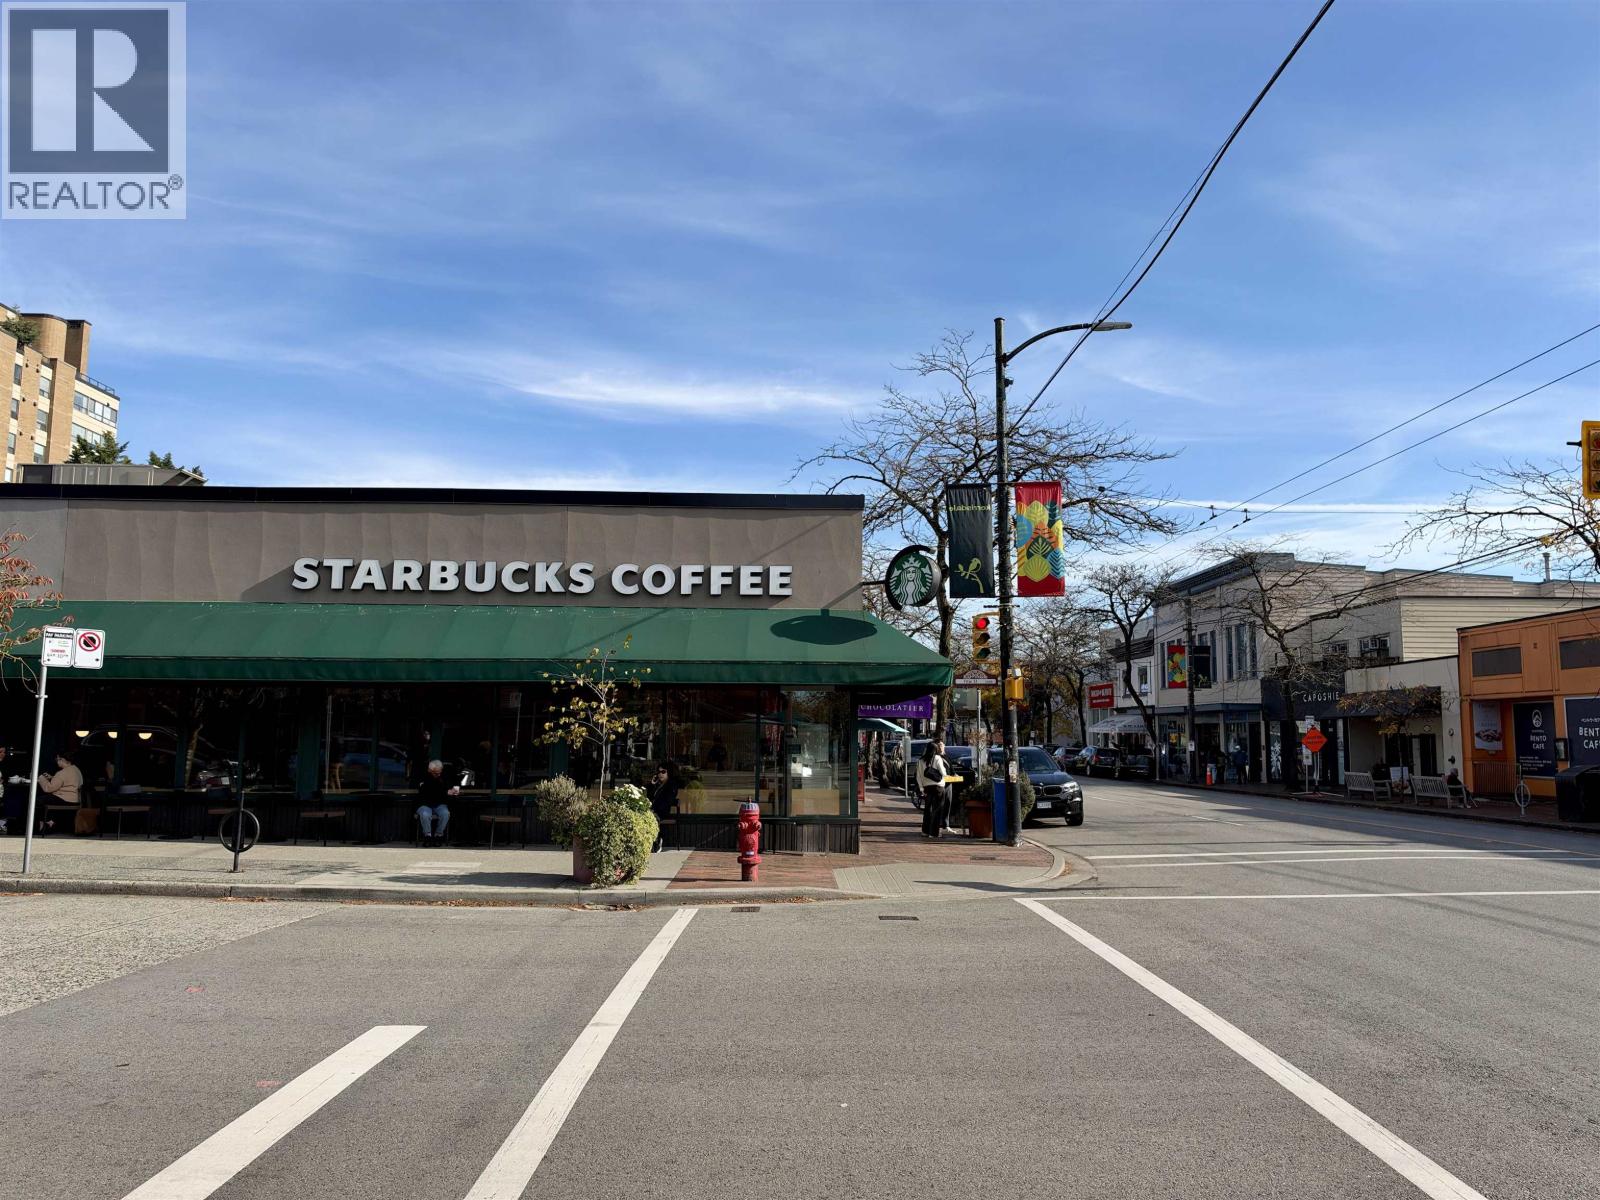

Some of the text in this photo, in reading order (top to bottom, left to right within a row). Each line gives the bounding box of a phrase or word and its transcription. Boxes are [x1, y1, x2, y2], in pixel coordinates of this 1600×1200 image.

[291, 557, 794, 596] STARBUCKS COFFEE
[1579, 726, 1600, 737] BENT
[1583, 739, 1600, 750] CAF
